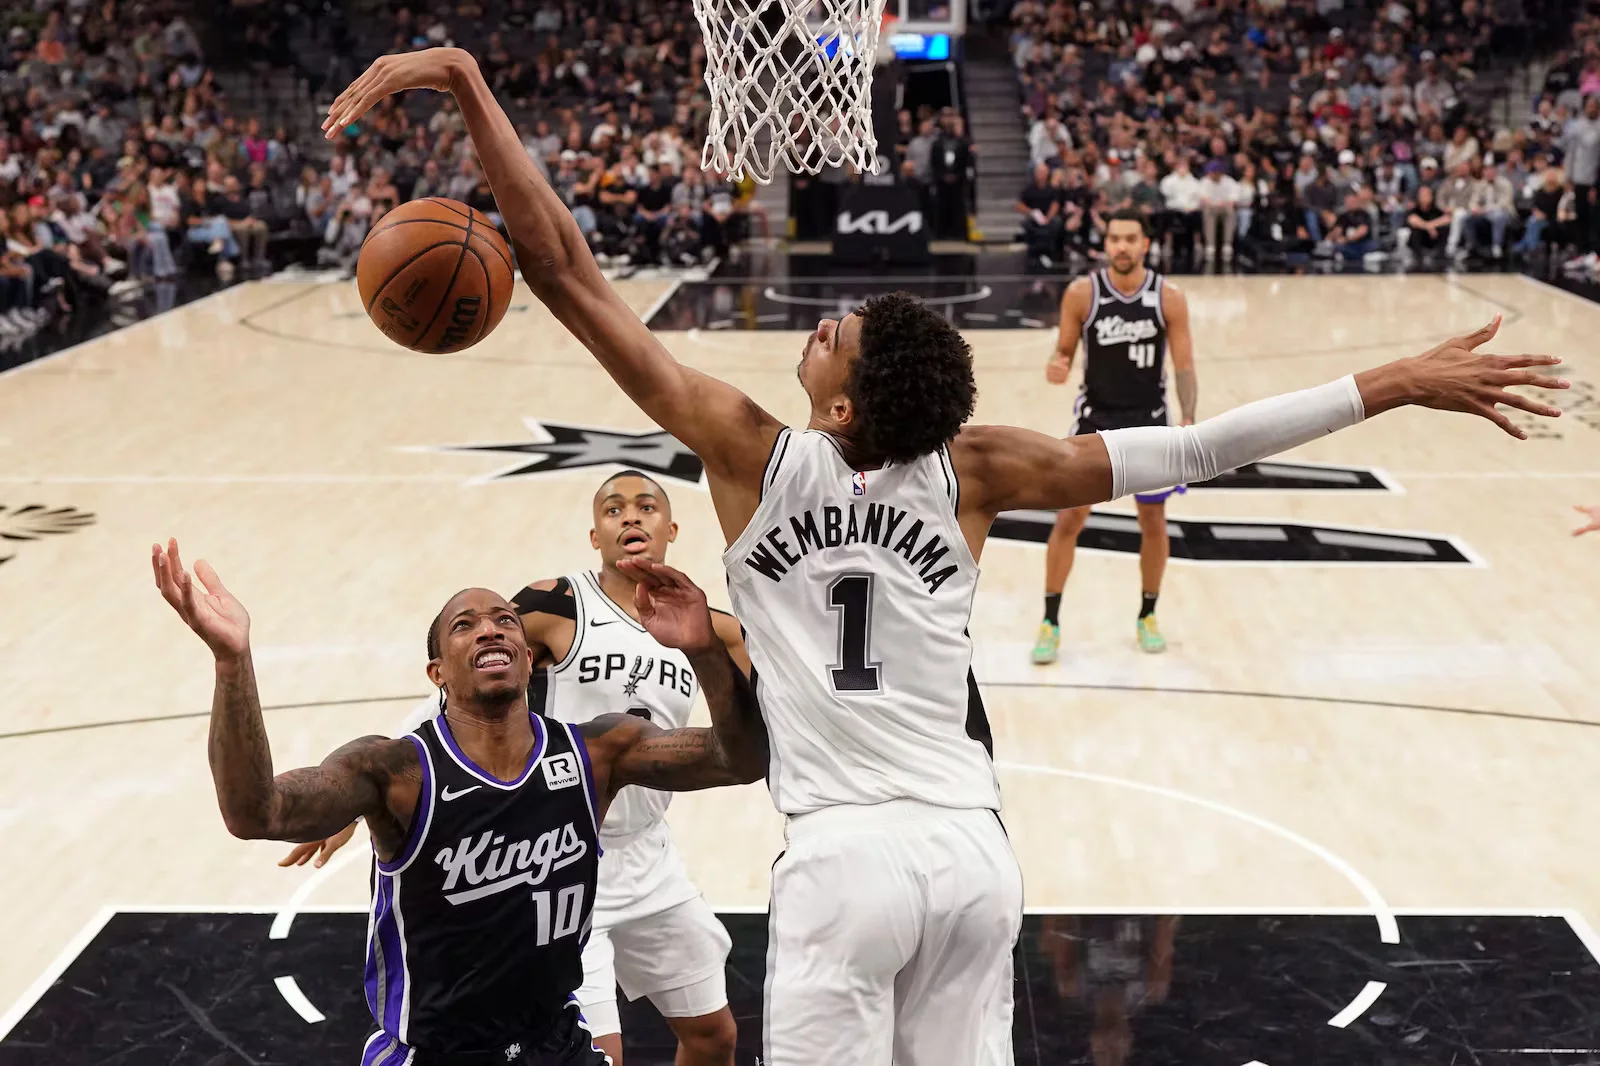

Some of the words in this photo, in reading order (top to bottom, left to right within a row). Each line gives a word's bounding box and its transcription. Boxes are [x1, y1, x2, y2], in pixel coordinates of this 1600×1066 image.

[837, 209, 923, 234] KIA
[1094, 315, 1158, 346] Kings
[1128, 343, 1156, 369] 41
[745, 502, 959, 595] WEMBANYAMA
[825, 571, 885, 697] 1
[578, 653, 693, 698] SPURS
[548, 758, 571, 777] R
[549, 776, 578, 787] REVIVER
[434, 821, 588, 906] Kings
[531, 883, 586, 947] 10
